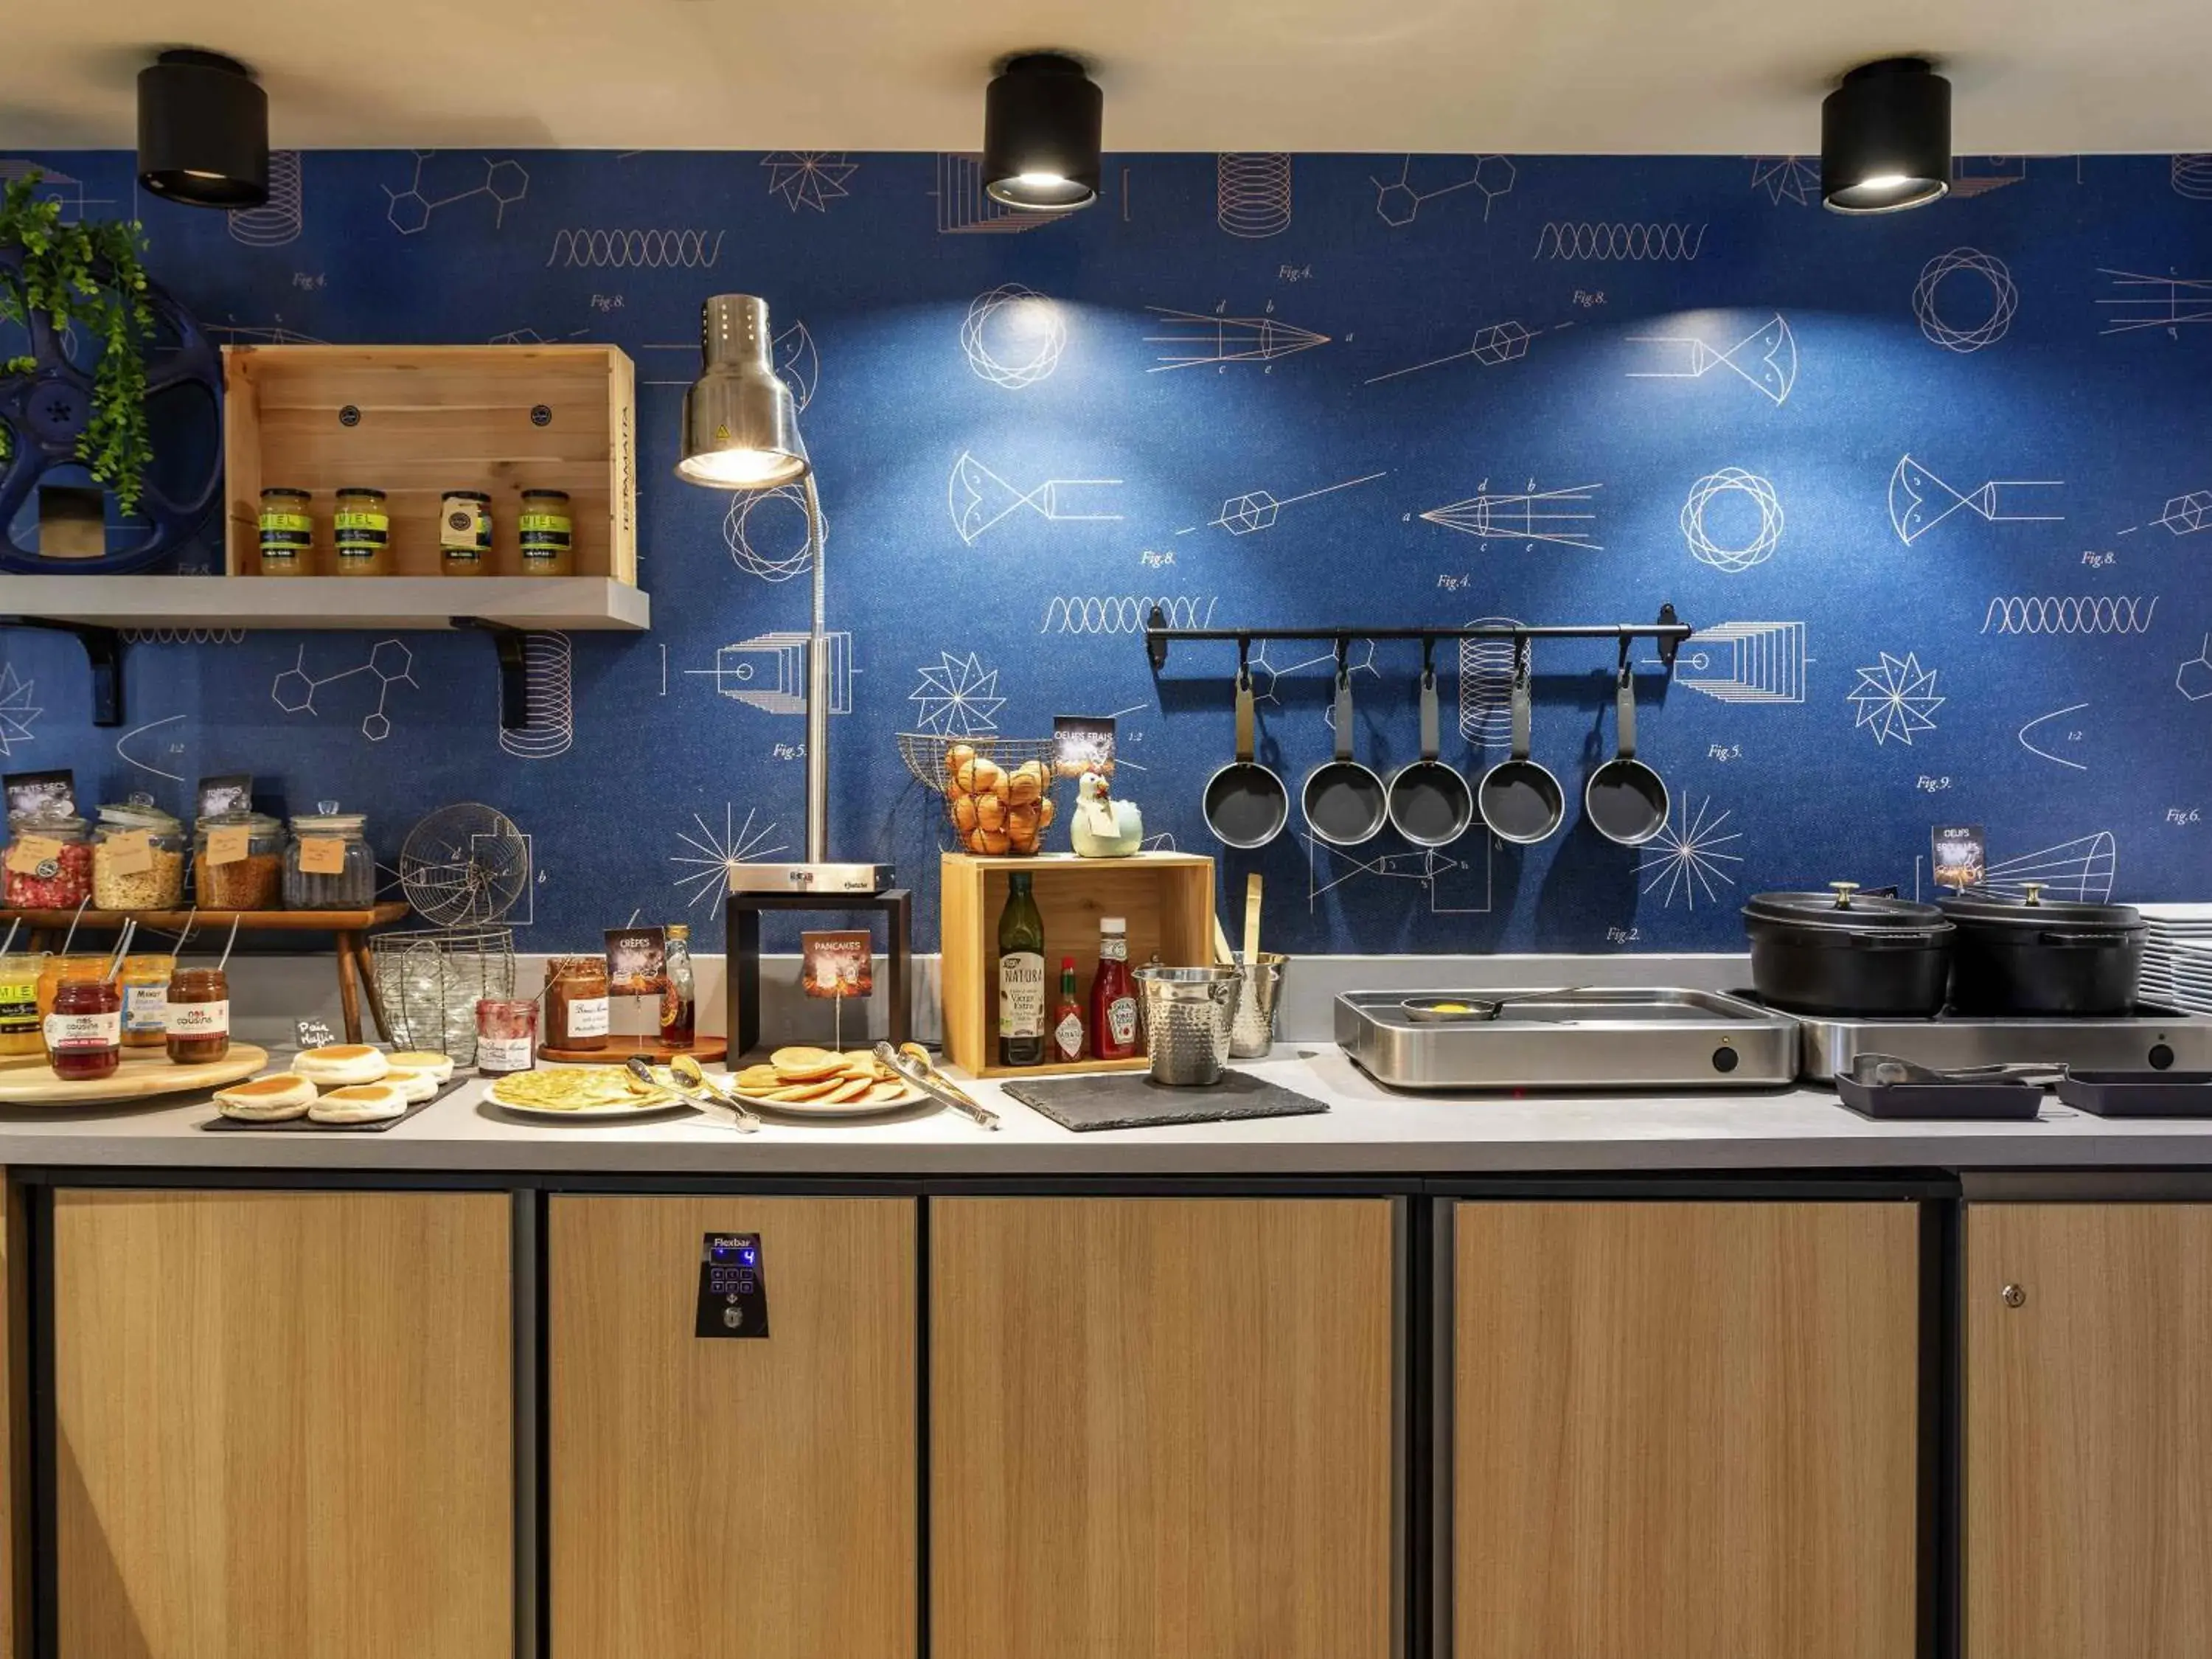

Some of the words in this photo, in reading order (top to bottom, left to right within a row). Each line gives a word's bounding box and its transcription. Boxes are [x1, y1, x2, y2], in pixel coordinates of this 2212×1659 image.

[814, 942, 861, 951] PANCAKES
[714, 1238, 751, 1247] Flexbar
[744, 1251, 754, 1263] 4
